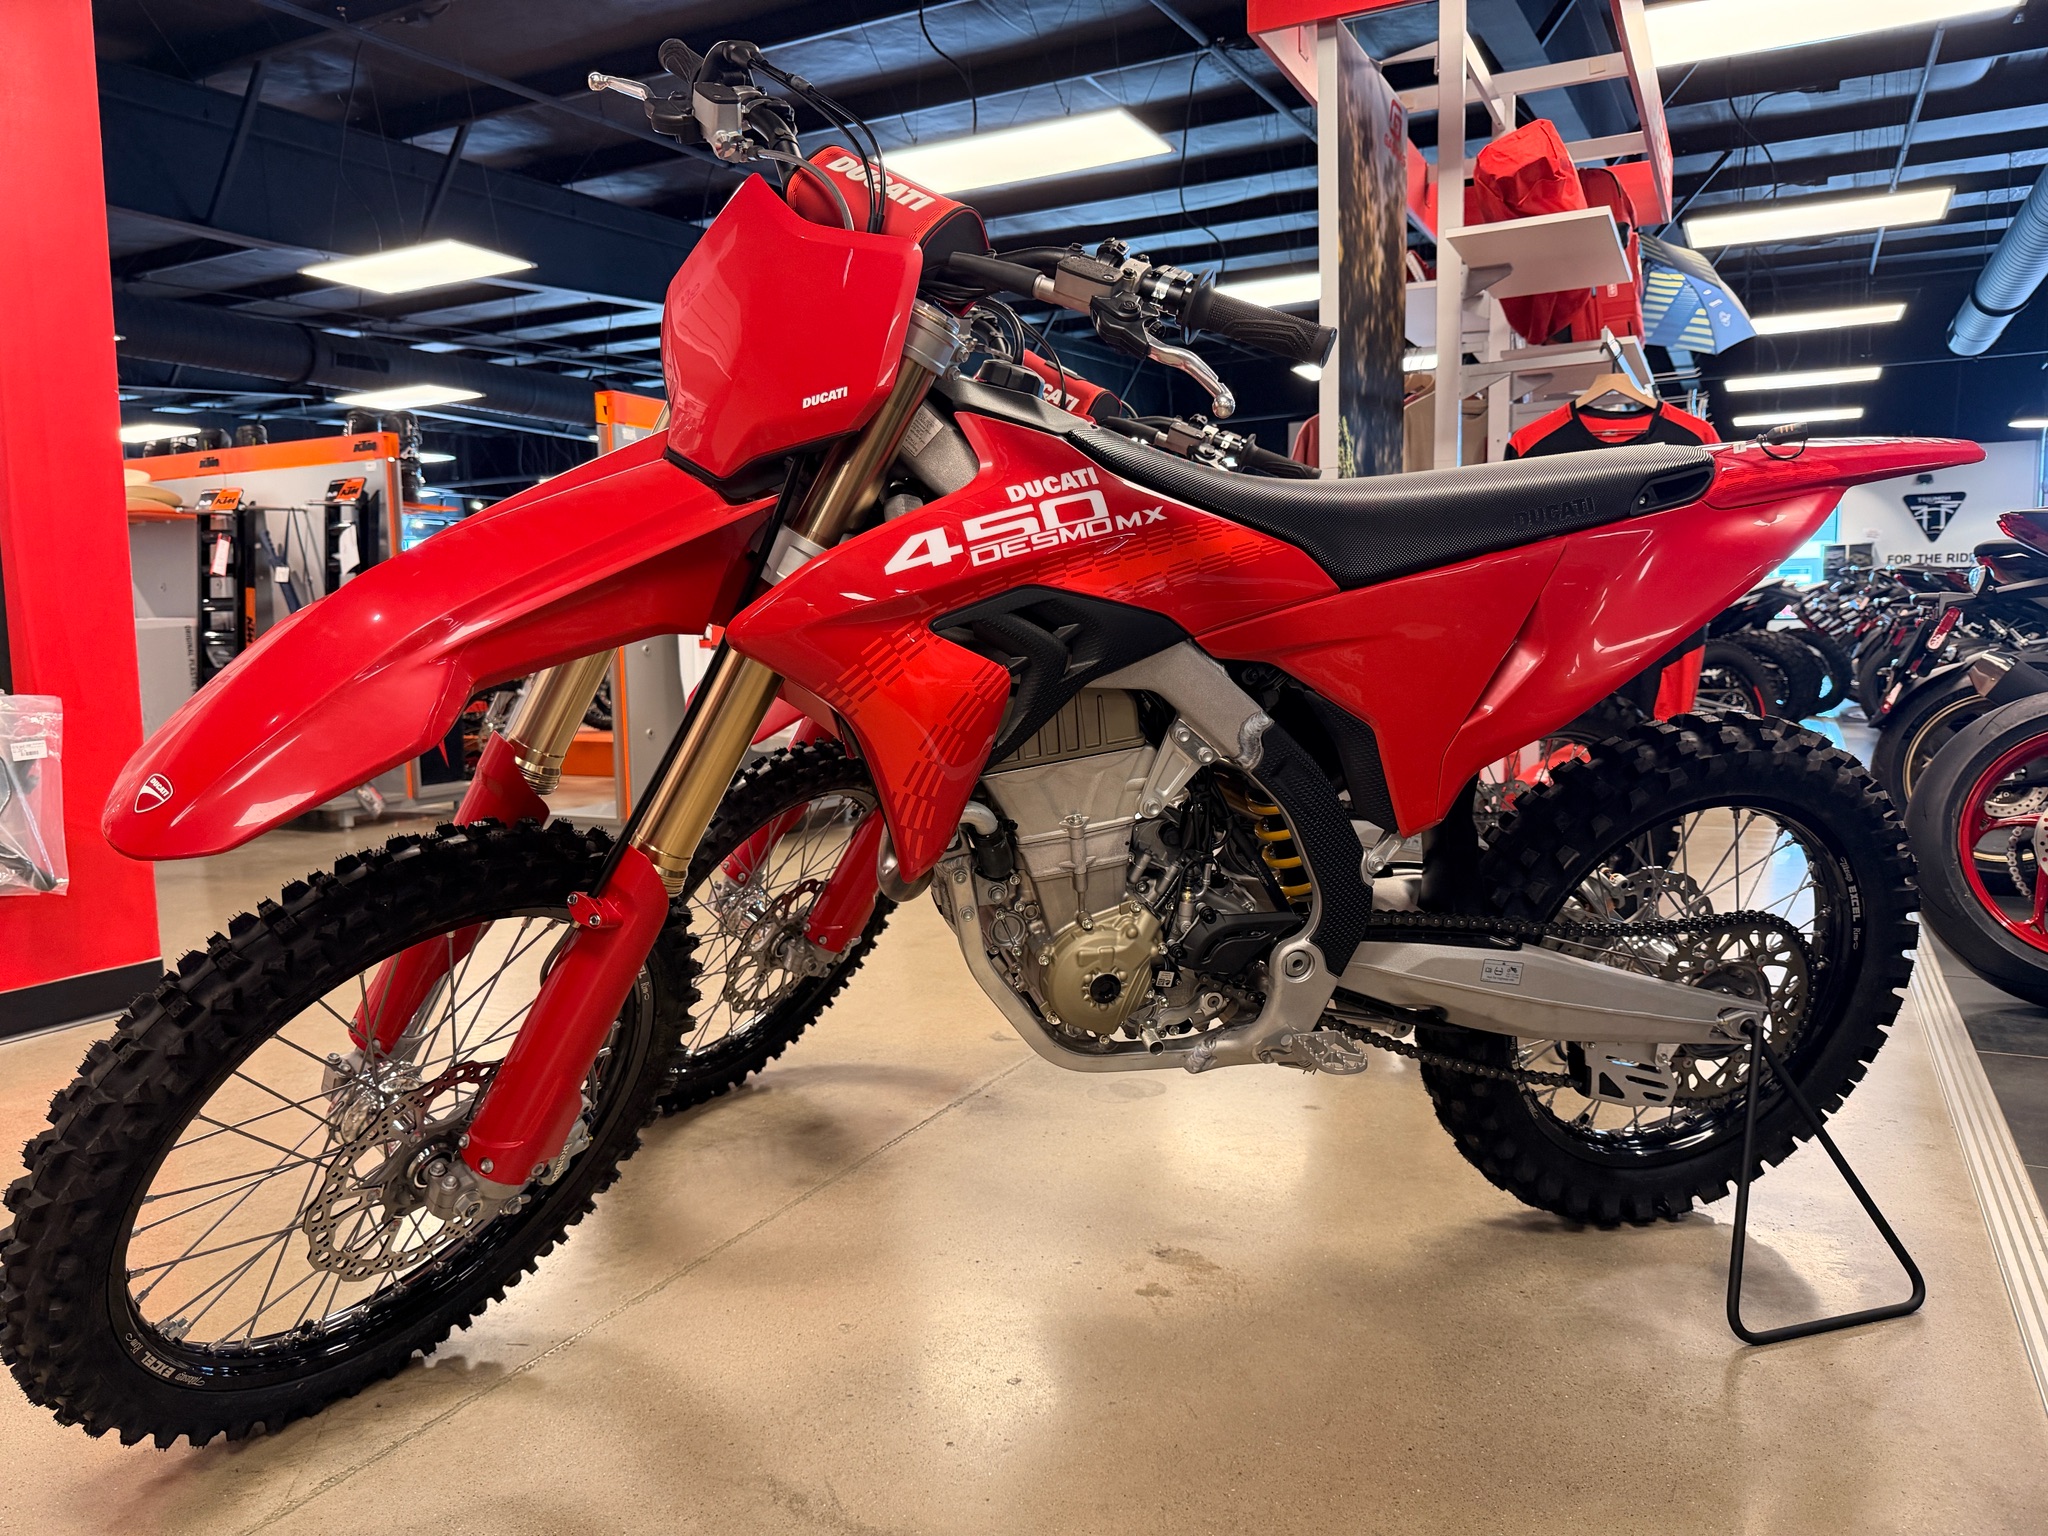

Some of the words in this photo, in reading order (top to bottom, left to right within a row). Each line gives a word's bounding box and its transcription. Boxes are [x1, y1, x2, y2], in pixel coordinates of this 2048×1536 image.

[802, 386, 848, 409] DUCATI
[353, 440, 377, 453] KTM
[1005, 466, 1100, 503] DUCATI
[1513, 497, 1595, 531] DUCATI
[884, 490, 1110, 576] 450
[969, 516, 1113, 567] DESMO
[1115, 505, 1168, 532] MX
[1887, 554, 1912, 565] FOR
[1917, 553, 1943, 564] THE
[150, 778, 169, 796] DUCATI
[1848, 885, 1861, 922] EXCEL
[551, 1143, 572, 1182] brembo
[125, 1332, 144, 1355] Rim
[140, 1350, 177, 1379] EXCEL
